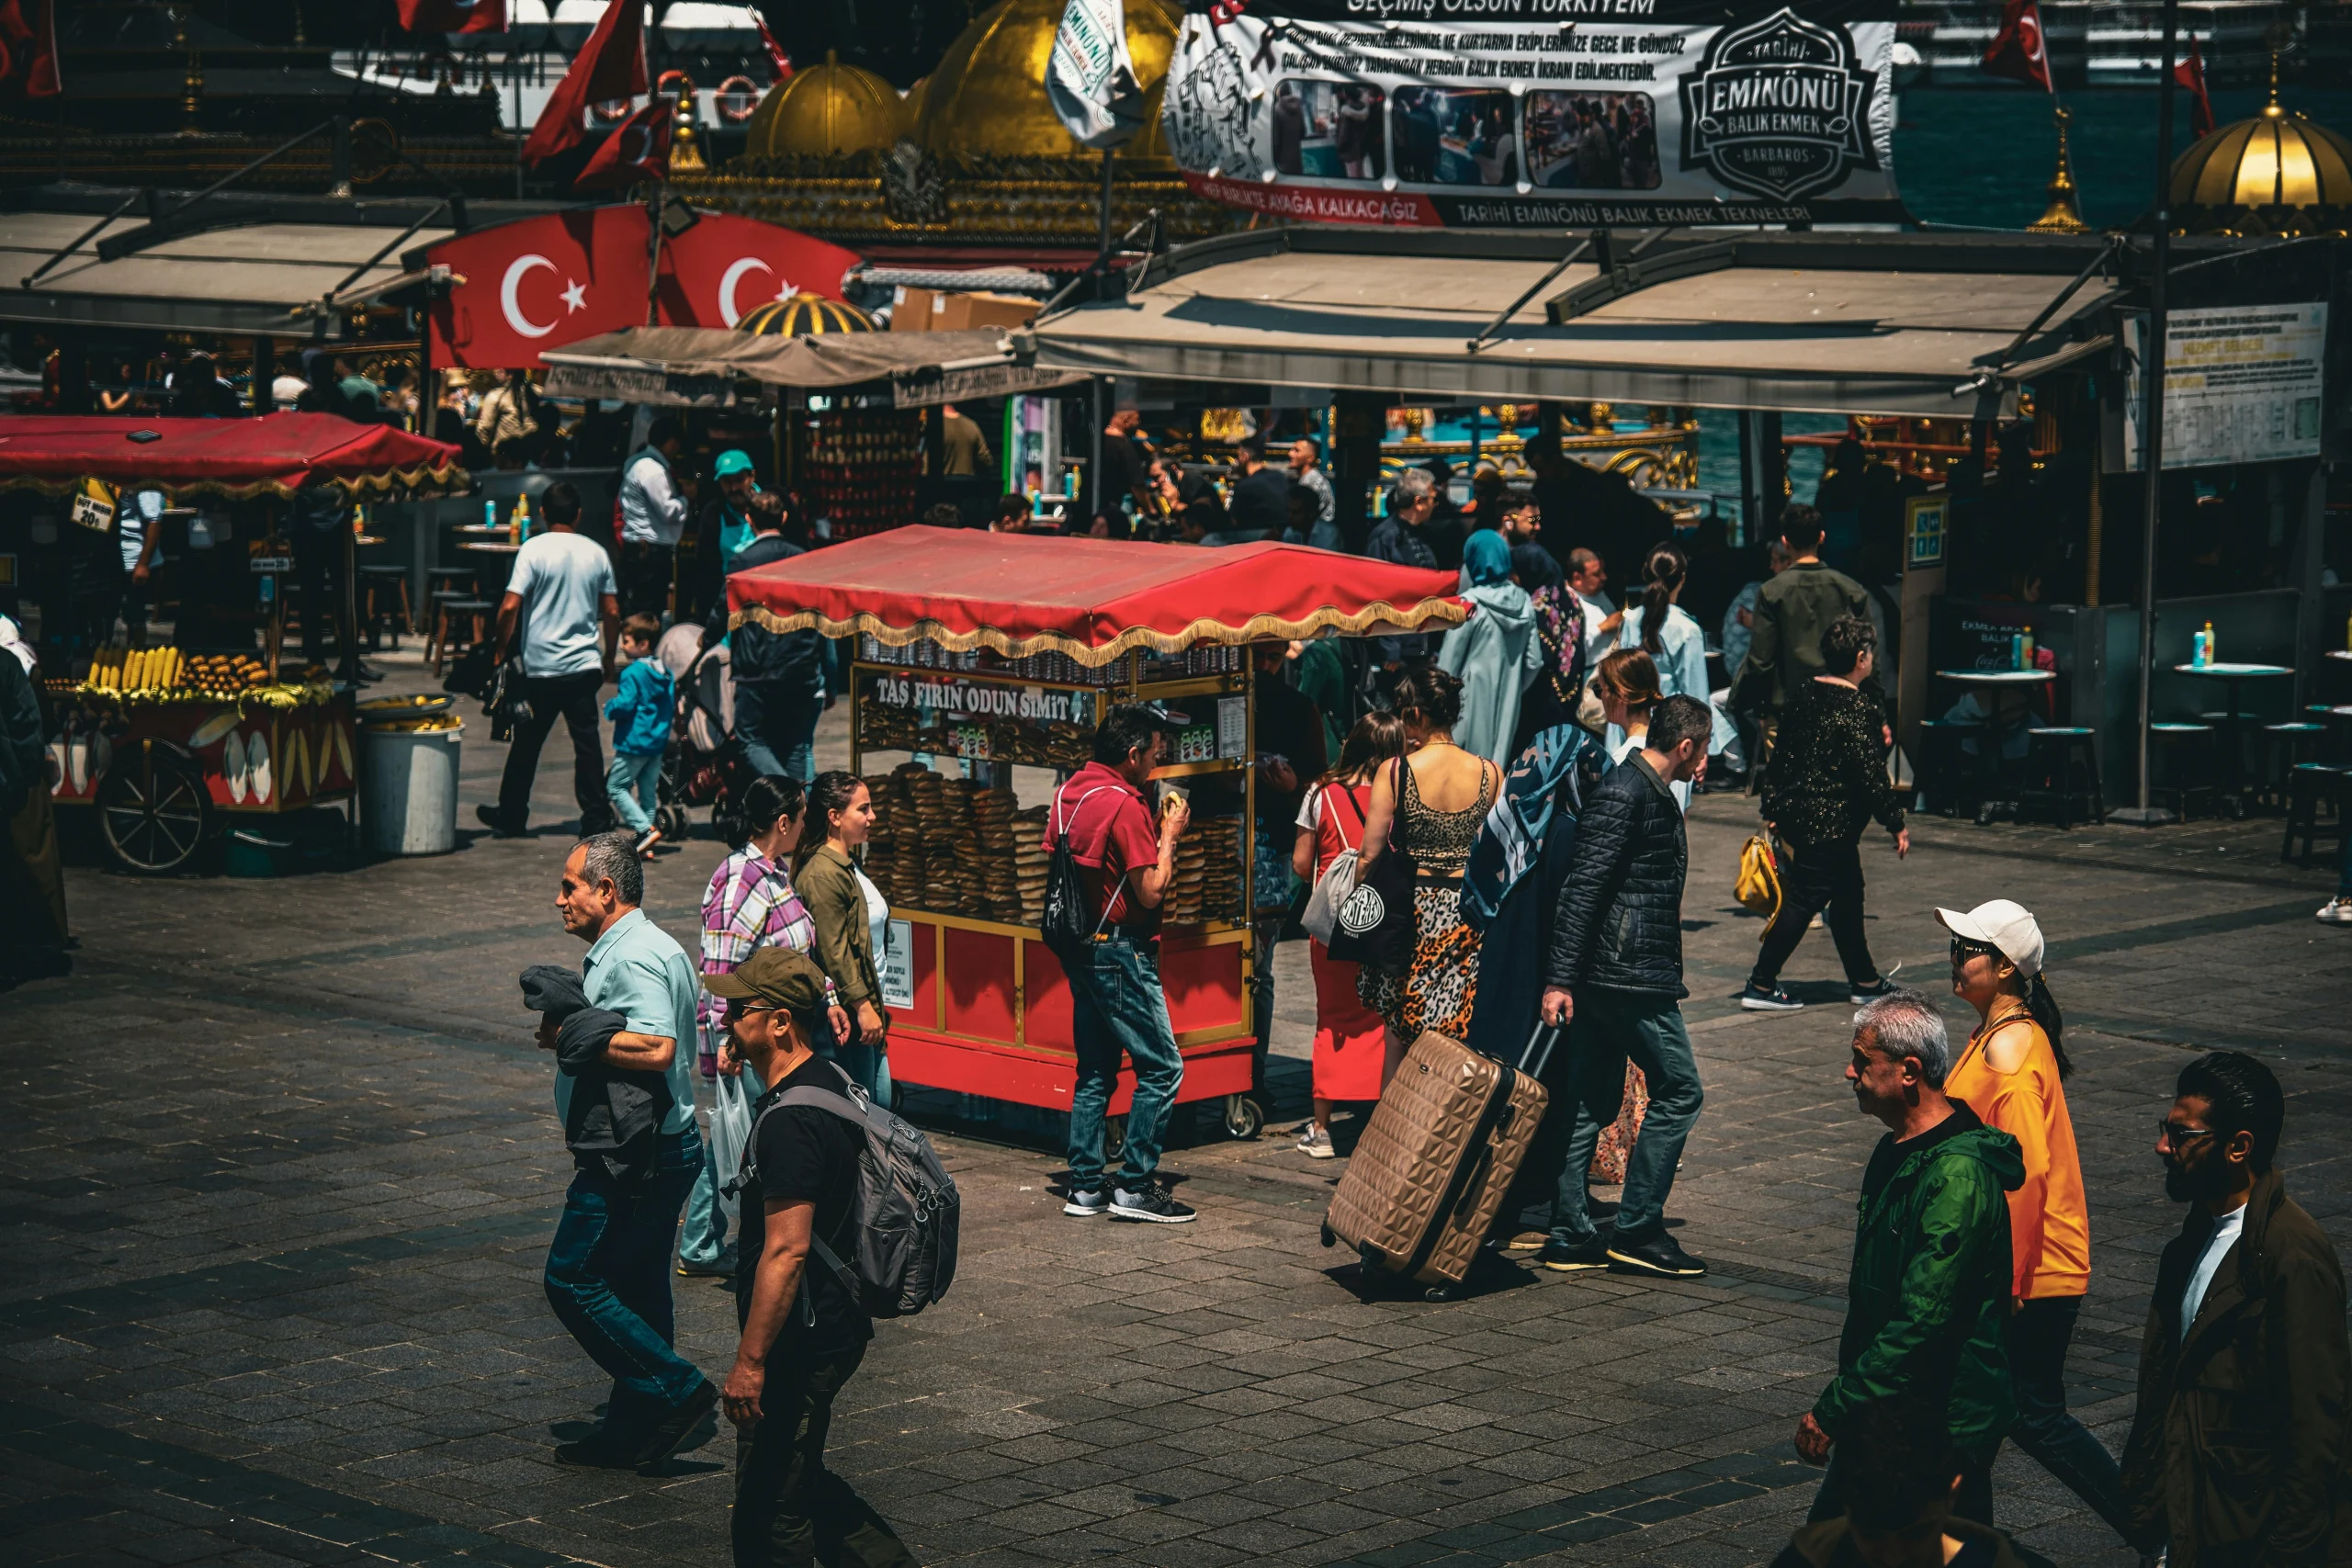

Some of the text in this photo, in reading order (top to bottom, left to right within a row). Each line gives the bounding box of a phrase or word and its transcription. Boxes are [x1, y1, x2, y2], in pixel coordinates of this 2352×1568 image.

[1590, 35, 1619, 53] GECE
[1622, 36, 1636, 54] VE
[1638, 32, 1686, 55] GÜNDÜZ
[1752, 38, 1808, 60] TARİHİ
[1467, 60, 1498, 77] BALIK
[1499, 61, 1535, 79] EKMEK
[1713, 70, 1838, 112] EMİNÖNÜ
[1728, 113, 1821, 134] BALIK EKMEK
[1743, 148, 1810, 164] BARBAROS
[1268, 190, 1316, 214] AYAĞA
[1317, 197, 1419, 221] KALKACAĞIZ
[1457, 201, 1812, 223] TARİHİ EMİNÖNÜ BALIK EKMEK TEKNELERİ
[876, 678, 910, 709] TAŞ
[913, 682, 964, 711] FIRIN
[967, 687, 1017, 716] ODUN
